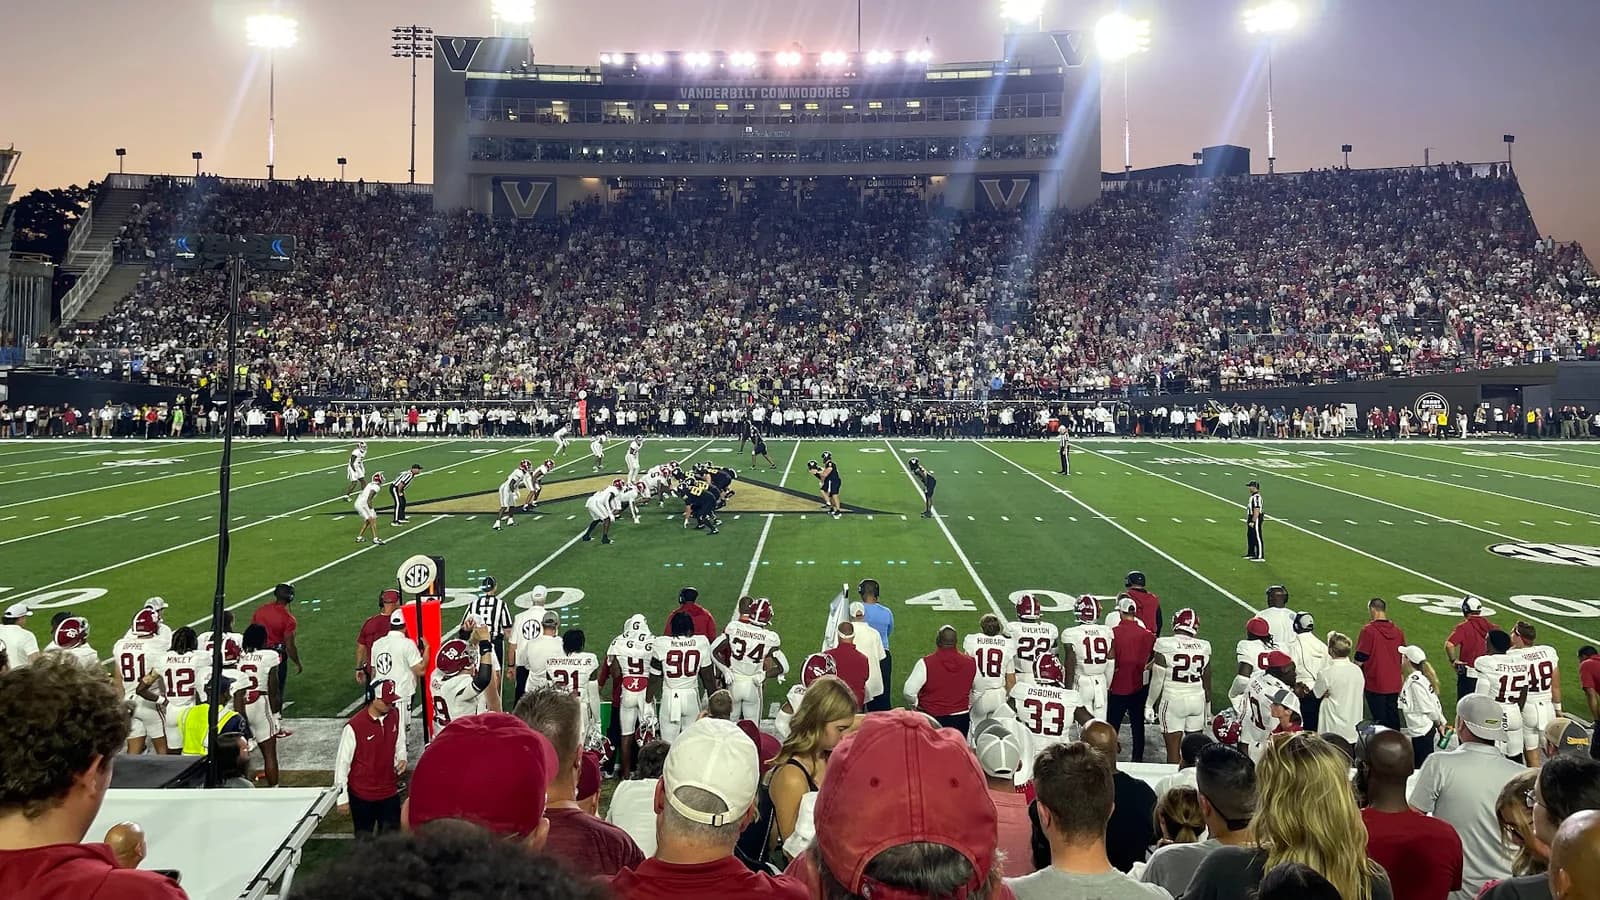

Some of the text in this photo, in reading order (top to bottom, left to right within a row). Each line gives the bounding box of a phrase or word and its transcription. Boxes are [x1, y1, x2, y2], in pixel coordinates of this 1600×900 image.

[679, 85, 851, 99] VANDERBILT COMMODORES
[405, 564, 429, 588] SEC
[522, 619, 541, 640] SEC
[736, 627, 767, 641] ROBINSON
[976, 636, 1006, 646] HUBBARD
[546, 658, 582, 667] KIRKPATRICK
[731, 637, 766, 664] 34
[975, 647, 1003, 677] 18
[1016, 637, 1051, 662] 22
[1082, 637, 1108, 664] 19
[120, 652, 145, 682] 81
[665, 649, 701, 679] 90
[1172, 653, 1205, 683] 23
[1527, 660, 1553, 693] 48
[165, 667, 196, 697] 12
[553, 669, 580, 692] 21
[1027, 687, 1063, 700] OSBORNE
[1495, 674, 1529, 704] 15
[1023, 698, 1065, 737] 33
